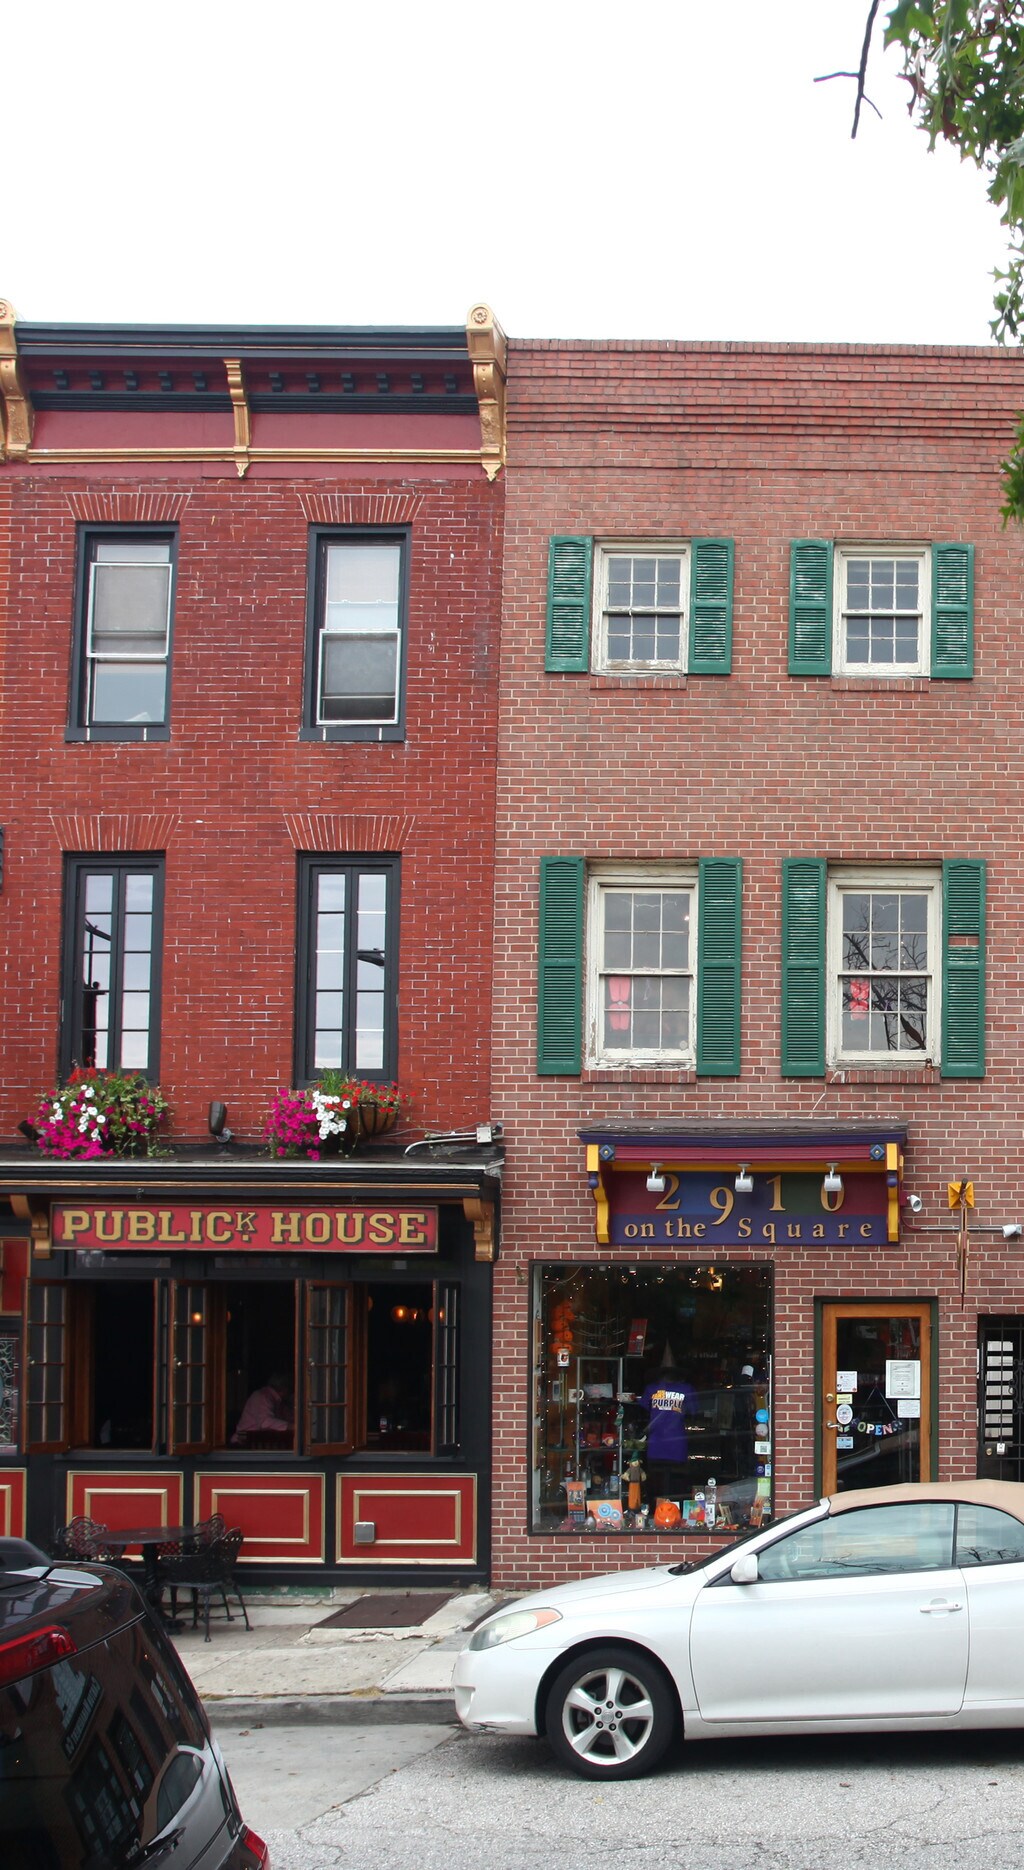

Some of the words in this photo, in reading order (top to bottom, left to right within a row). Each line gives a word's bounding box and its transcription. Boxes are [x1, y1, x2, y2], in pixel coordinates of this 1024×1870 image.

[271, 1212, 426, 1244] HOUSE
[624, 1223, 656, 1238] on
[665, 1218, 706, 1238] the
[738, 1217, 872, 1244] Square
[857, 1422, 893, 1436] OPEN
